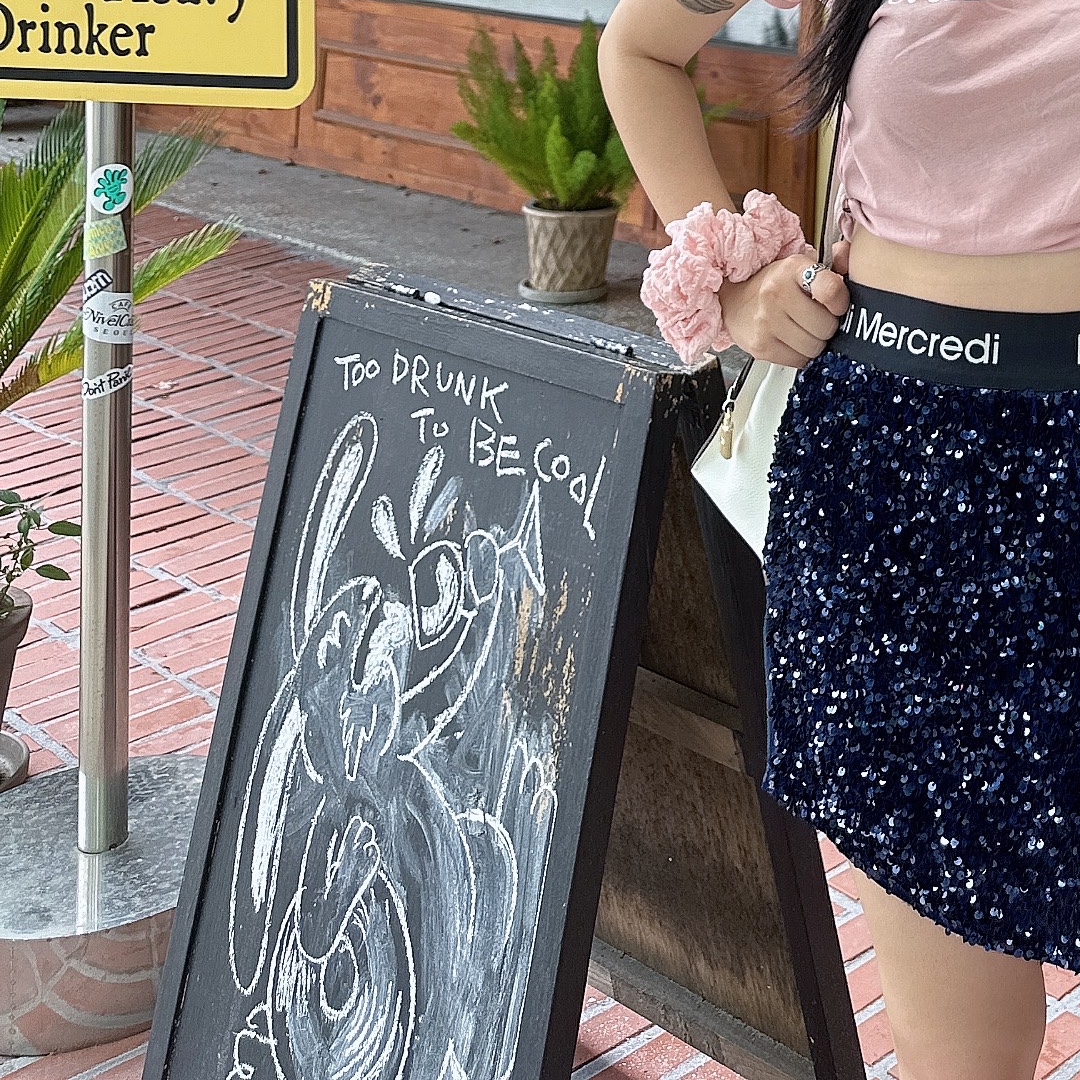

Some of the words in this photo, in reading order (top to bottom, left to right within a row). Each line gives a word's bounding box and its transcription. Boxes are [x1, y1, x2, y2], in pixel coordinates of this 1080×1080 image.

[854, 306, 1000, 366] Mercredi
[391, 348, 509, 424] DRUNK
[469, 416, 528, 477] BE
